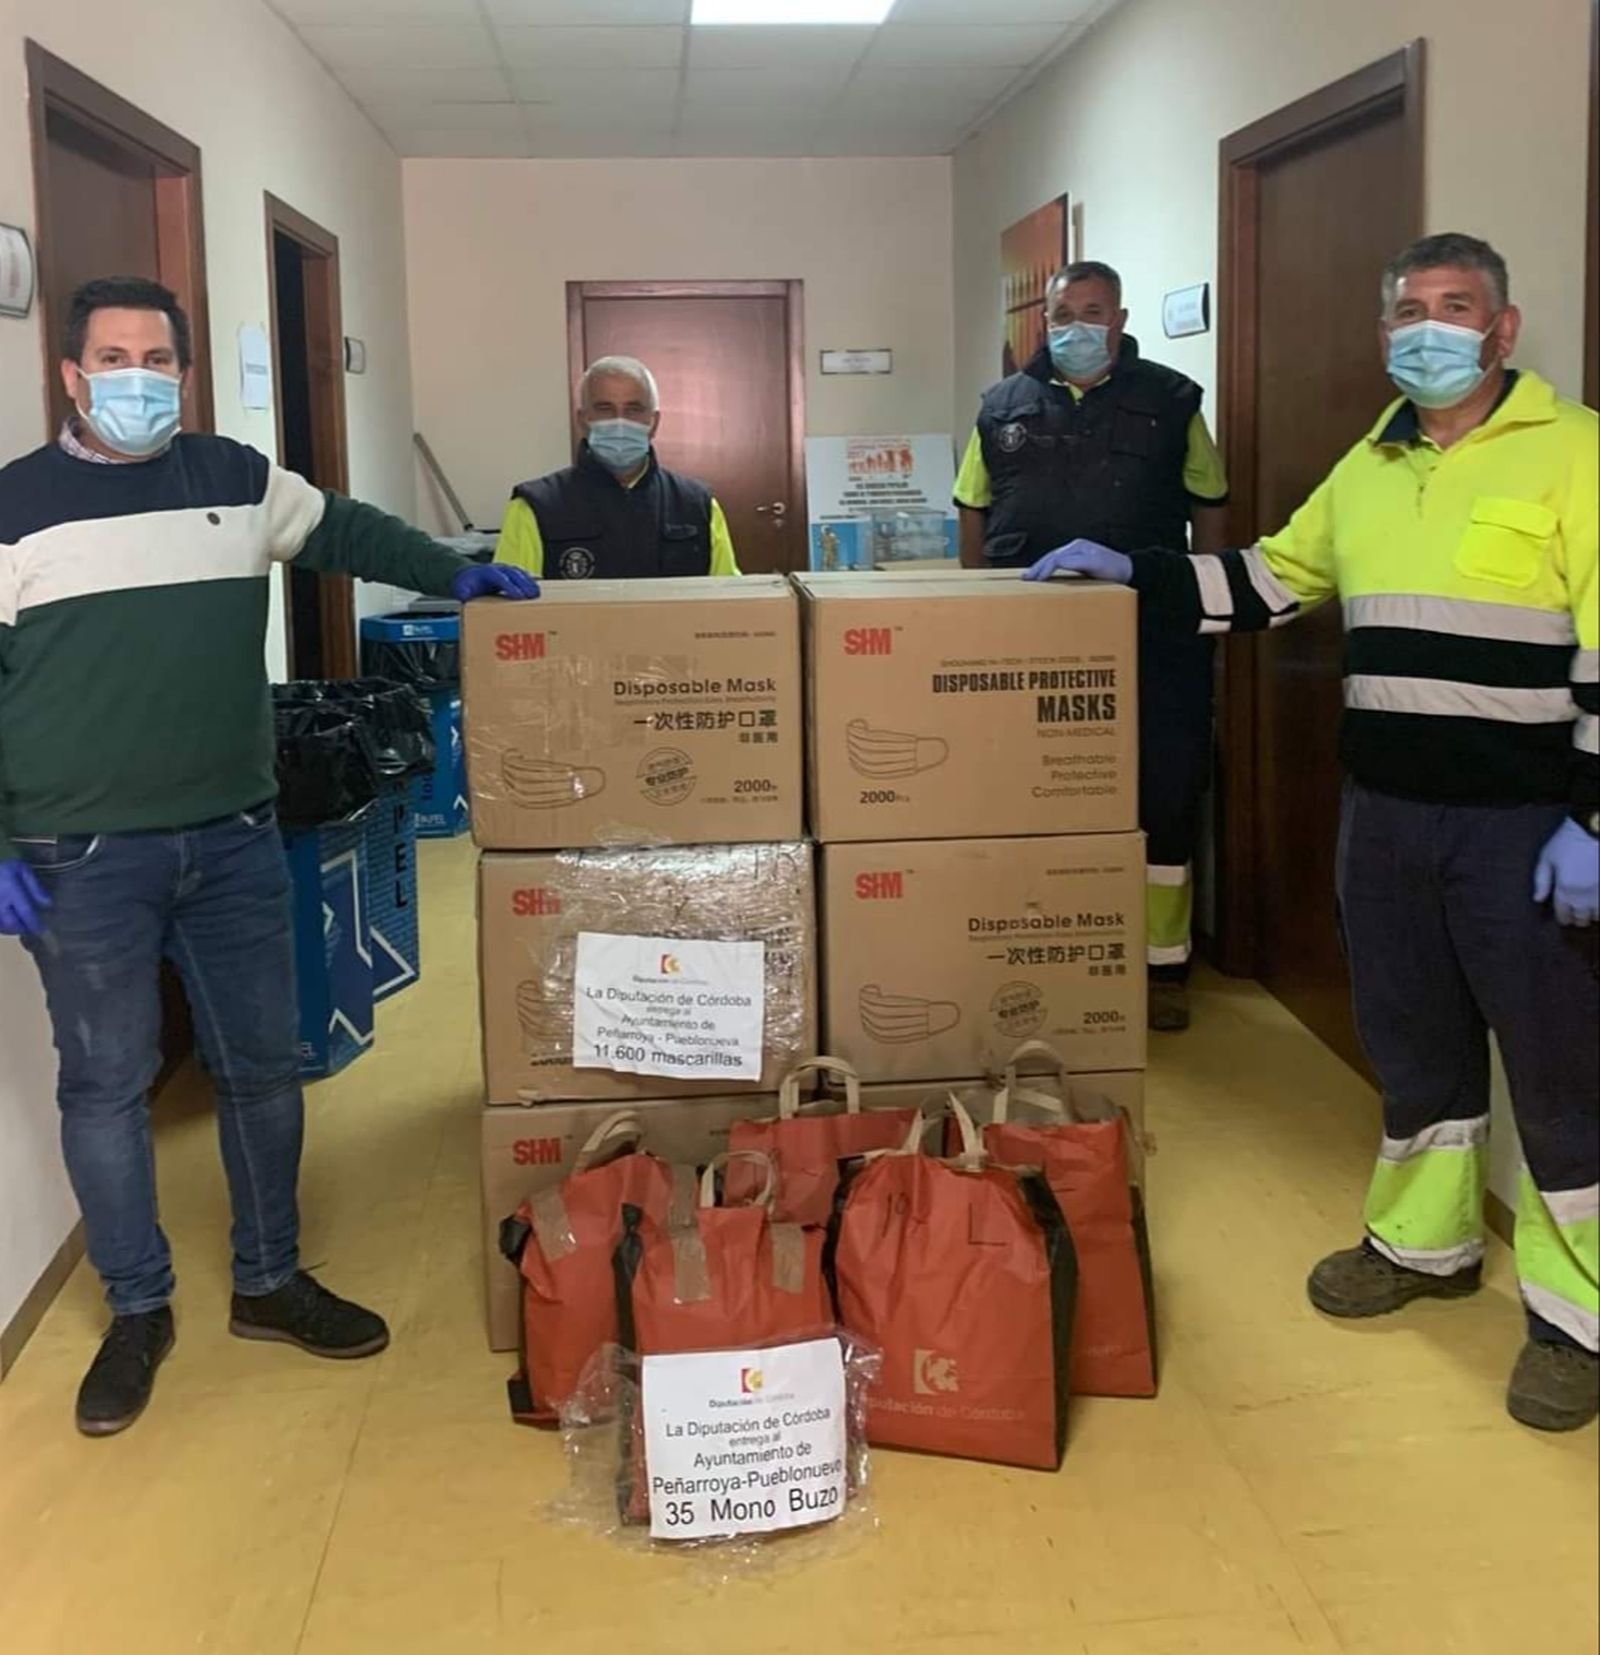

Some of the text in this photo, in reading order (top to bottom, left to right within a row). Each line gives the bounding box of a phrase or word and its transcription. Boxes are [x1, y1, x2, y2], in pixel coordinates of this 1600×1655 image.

[496, 633, 546, 661] SHM
[844, 628, 891, 655] SHM
[614, 678, 776, 697] Disposable Mask
[933, 669, 1116, 693] DISPOSABLE PROTECTIVE
[1037, 693, 1116, 723] MASKS
[633, 709, 778, 731] 一次性防护口罩
[1042, 753, 1117, 766] Breathable
[1051, 768, 1117, 781] Protective
[1031, 784, 1117, 799] Comfortable
[856, 871, 903, 899] SHM
[968, 912, 1125, 933] Disposable Mask
[986, 943, 1126, 965] 一次性防护口罩
[586, 986, 752, 1007] La Diputación de Córdoba
[620, 1013, 716, 1032] Ayuntamiento de
[596, 1026, 654, 1044] Peñarroya
[593, 1044, 646, 1062] 11.600
[651, 1050, 743, 1067] mascarillas
[665, 1407, 831, 1438] La Diputación de Córdoba
[729, 1432, 782, 1448] entrega al
[693, 1441, 812, 1470] Ayuntamiento de
[665, 1486, 839, 1526] 35 Mono Buzo
